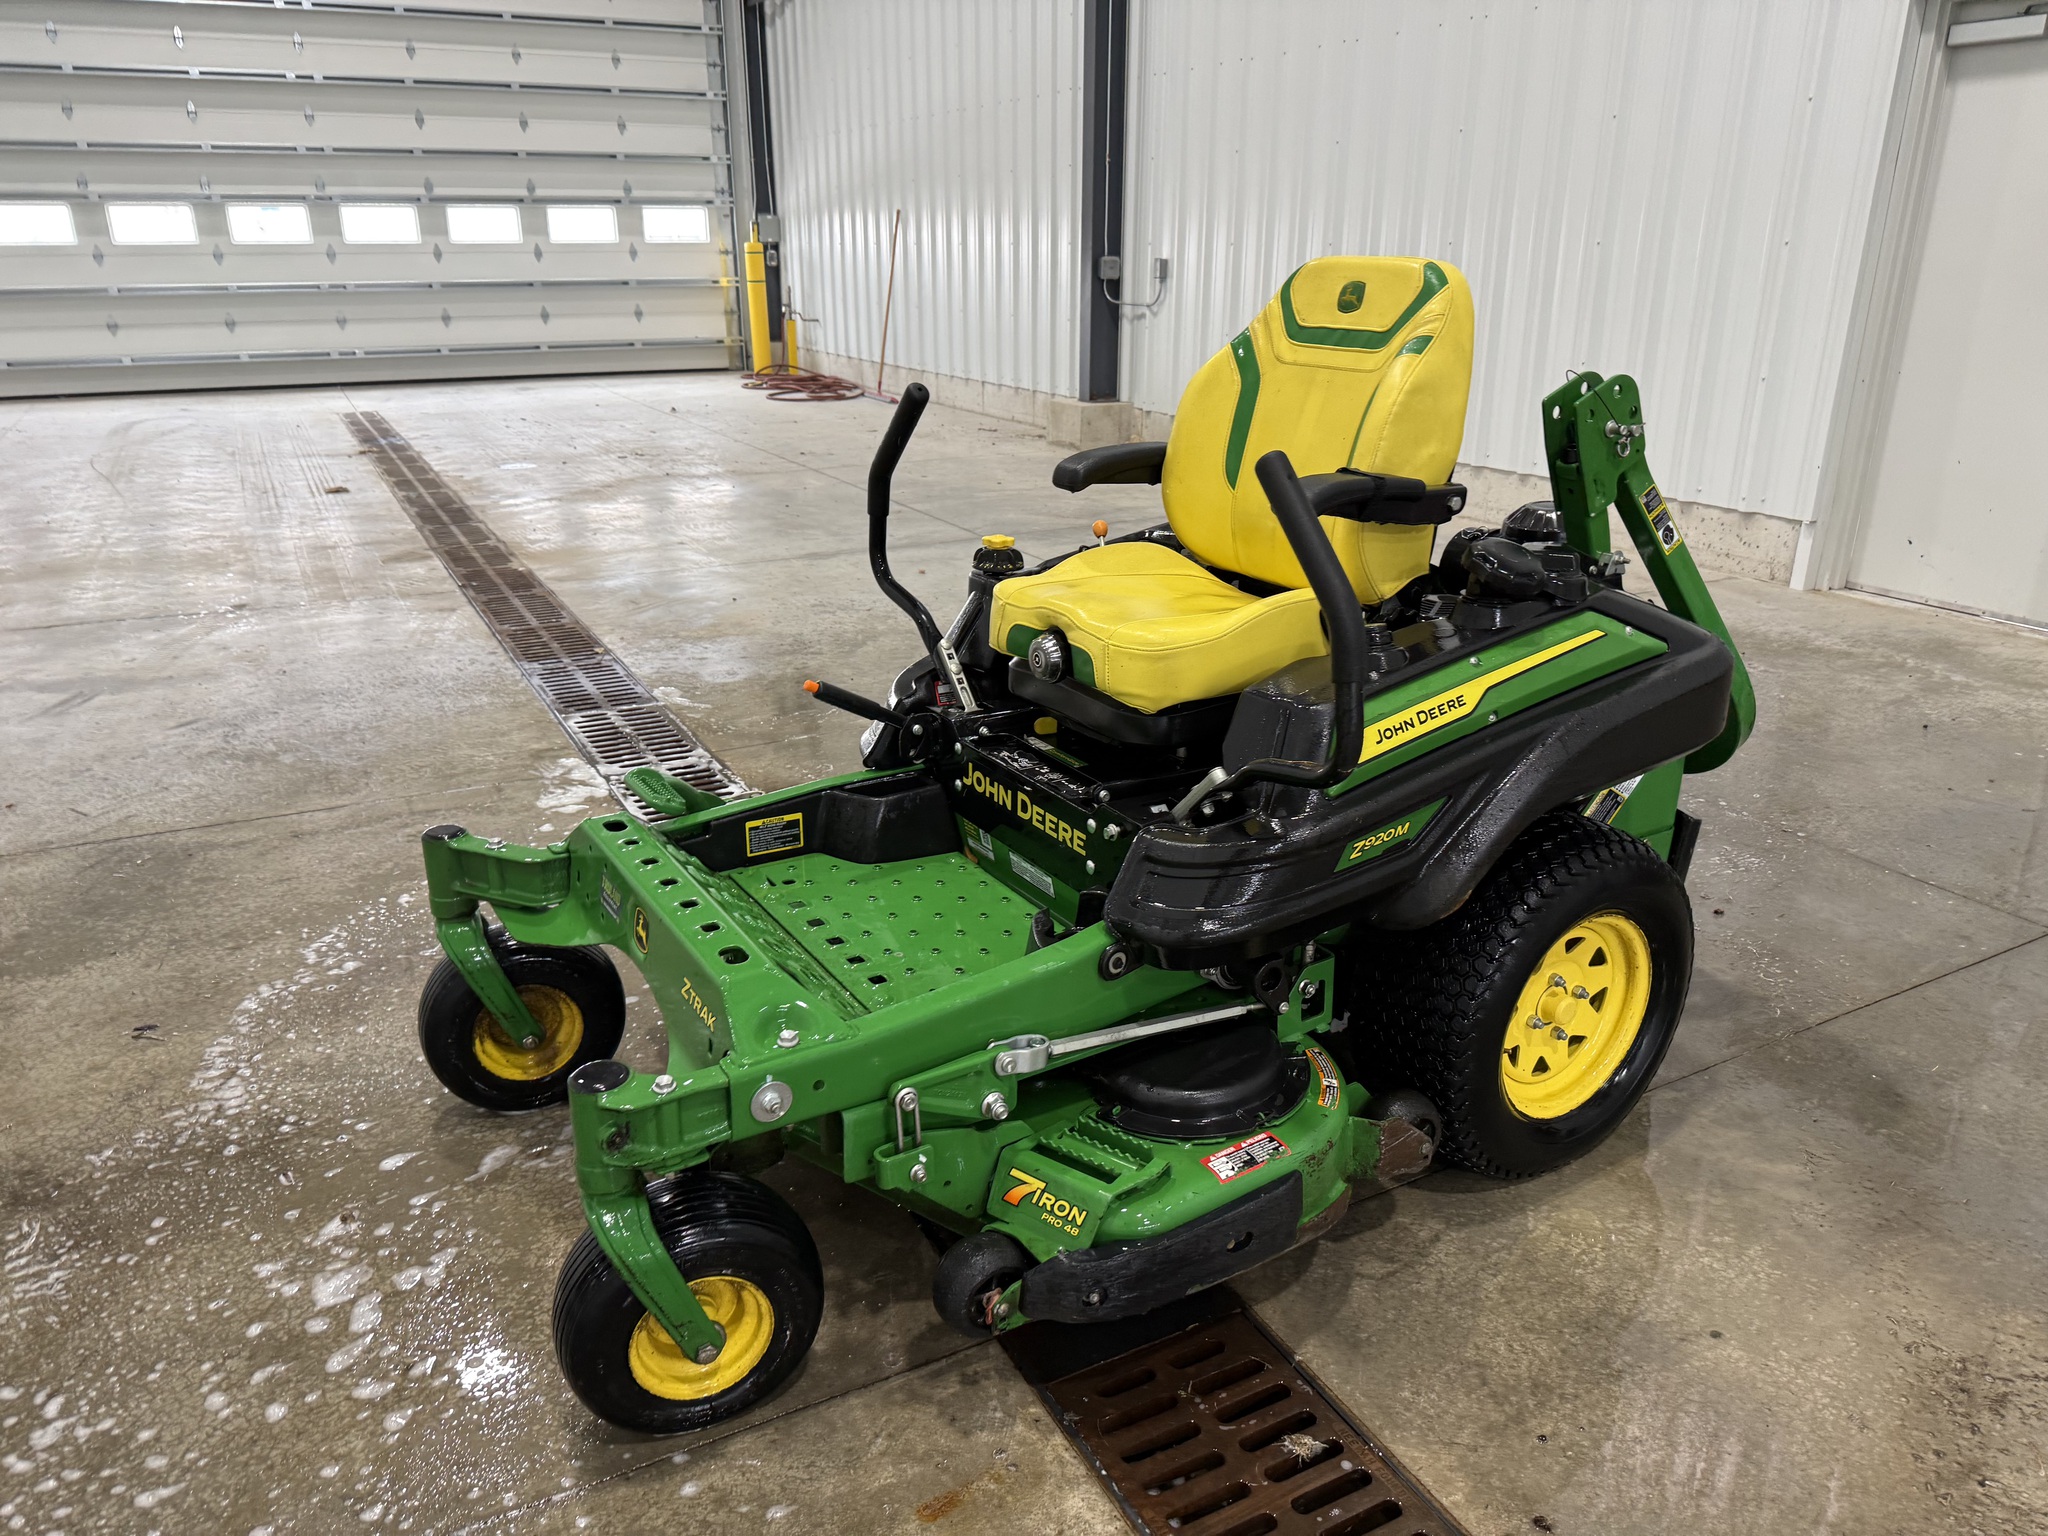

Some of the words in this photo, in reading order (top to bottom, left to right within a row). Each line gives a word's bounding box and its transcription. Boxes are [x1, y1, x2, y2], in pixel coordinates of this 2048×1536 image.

[1376, 717, 1416, 745] JOHN
[1416, 694, 1467, 726] DEERE
[962, 762, 1012, 811] JOHN
[1017, 791, 1087, 856] DEERE
[1349, 821, 1411, 860] Z920M
[681, 976, 717, 1033] ZTRAK
[1040, 1212, 1063, 1228] PRO
[1063, 1224, 1080, 1237] 48
